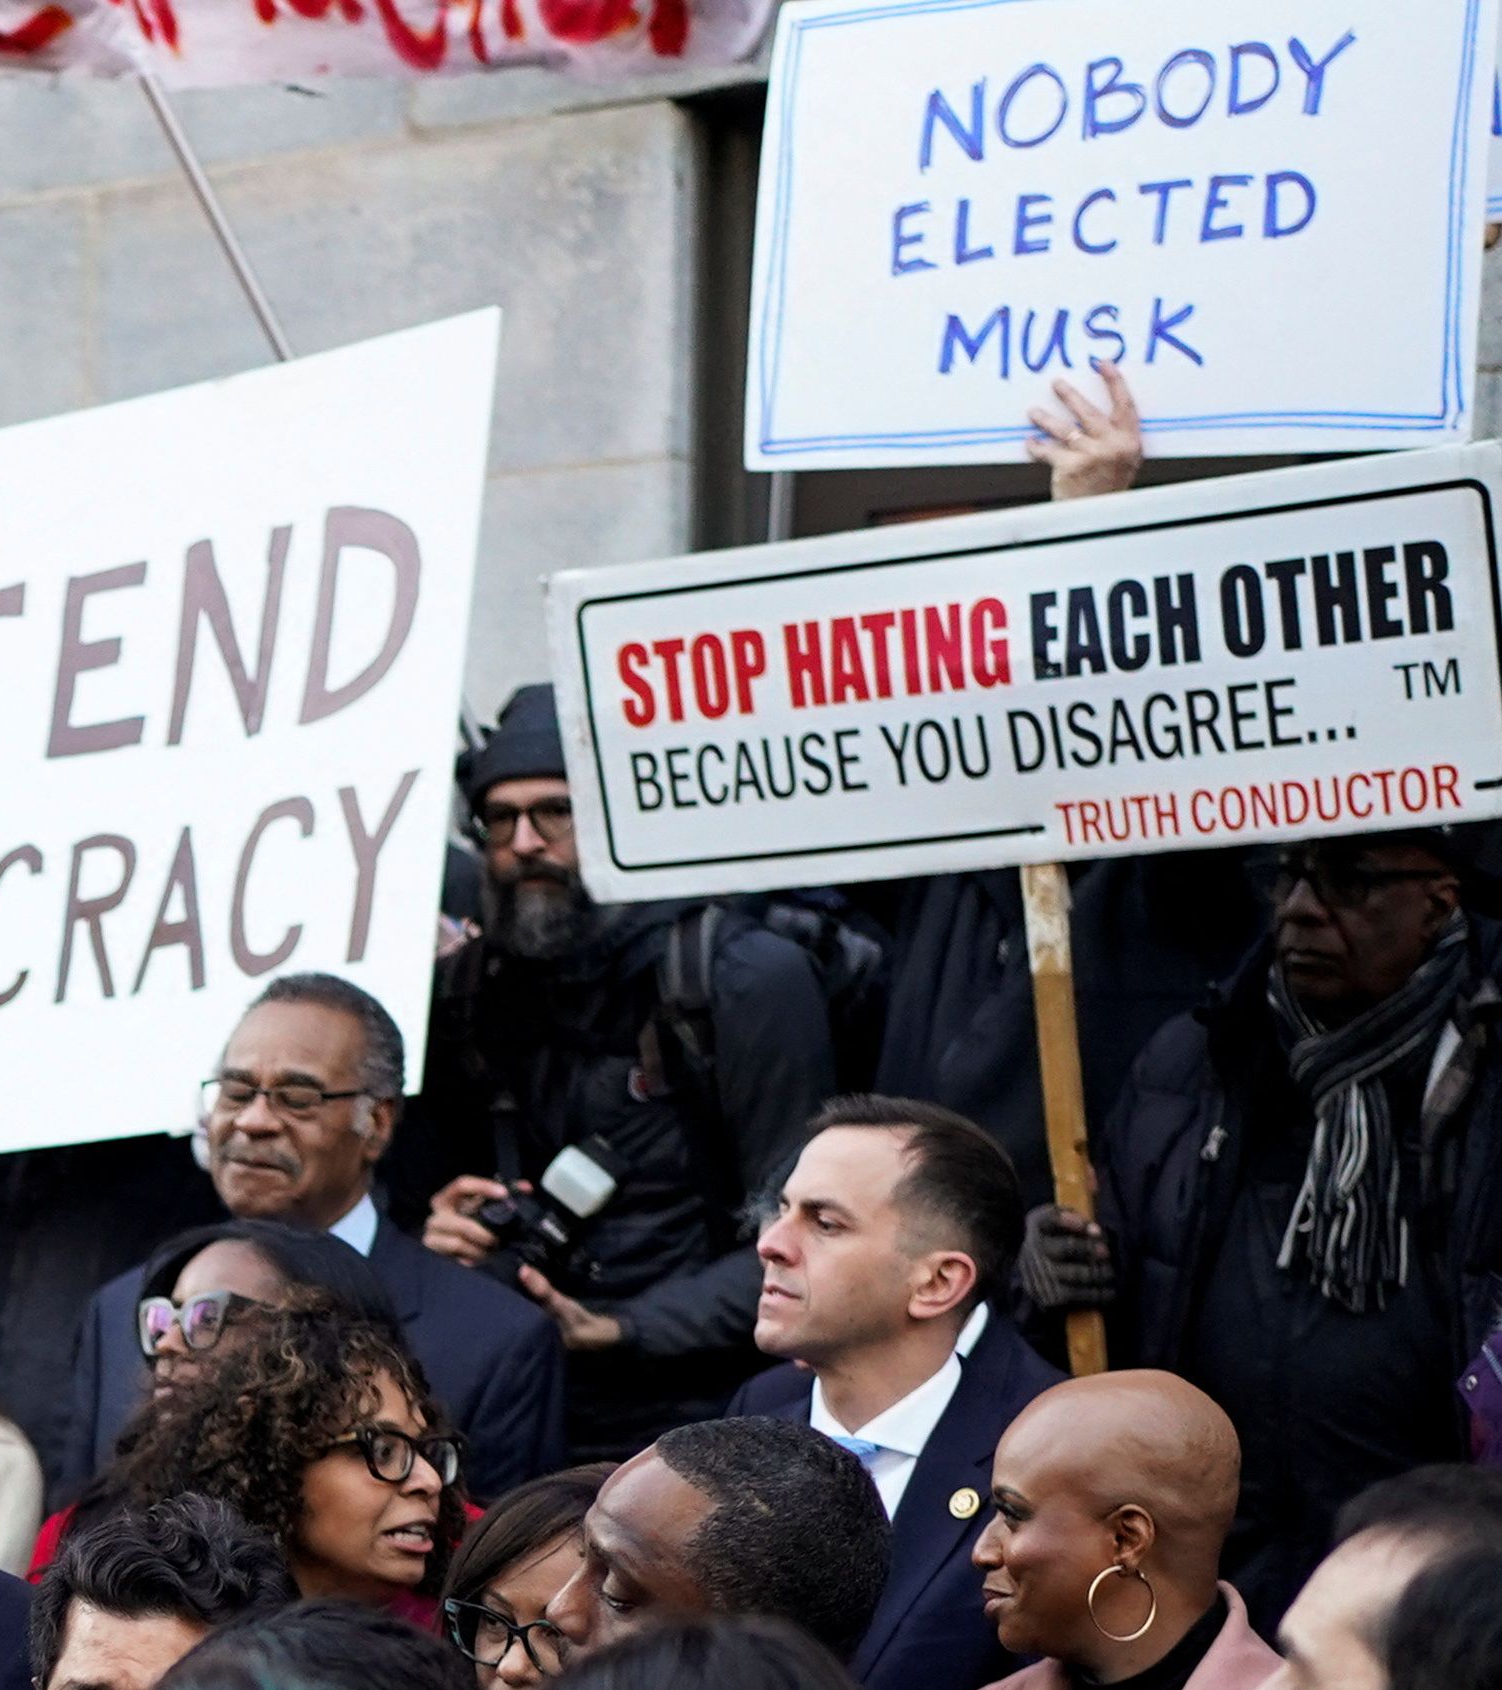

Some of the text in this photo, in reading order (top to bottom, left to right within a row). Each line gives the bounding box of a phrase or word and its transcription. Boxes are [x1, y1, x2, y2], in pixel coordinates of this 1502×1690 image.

[920, 28, 1357, 174] NOBODY
[891, 170, 1317, 277] ELECTED
[938, 297, 1204, 380] MUSK
[617, 540, 1456, 729] STOP HATING EACH OTHER
[1393, 658, 1463, 702] TM
[630, 678, 1359, 812] BECAUSE YOU DISAGREE...
[1055, 763, 1462, 847] TRUTH CONDUCTOR
